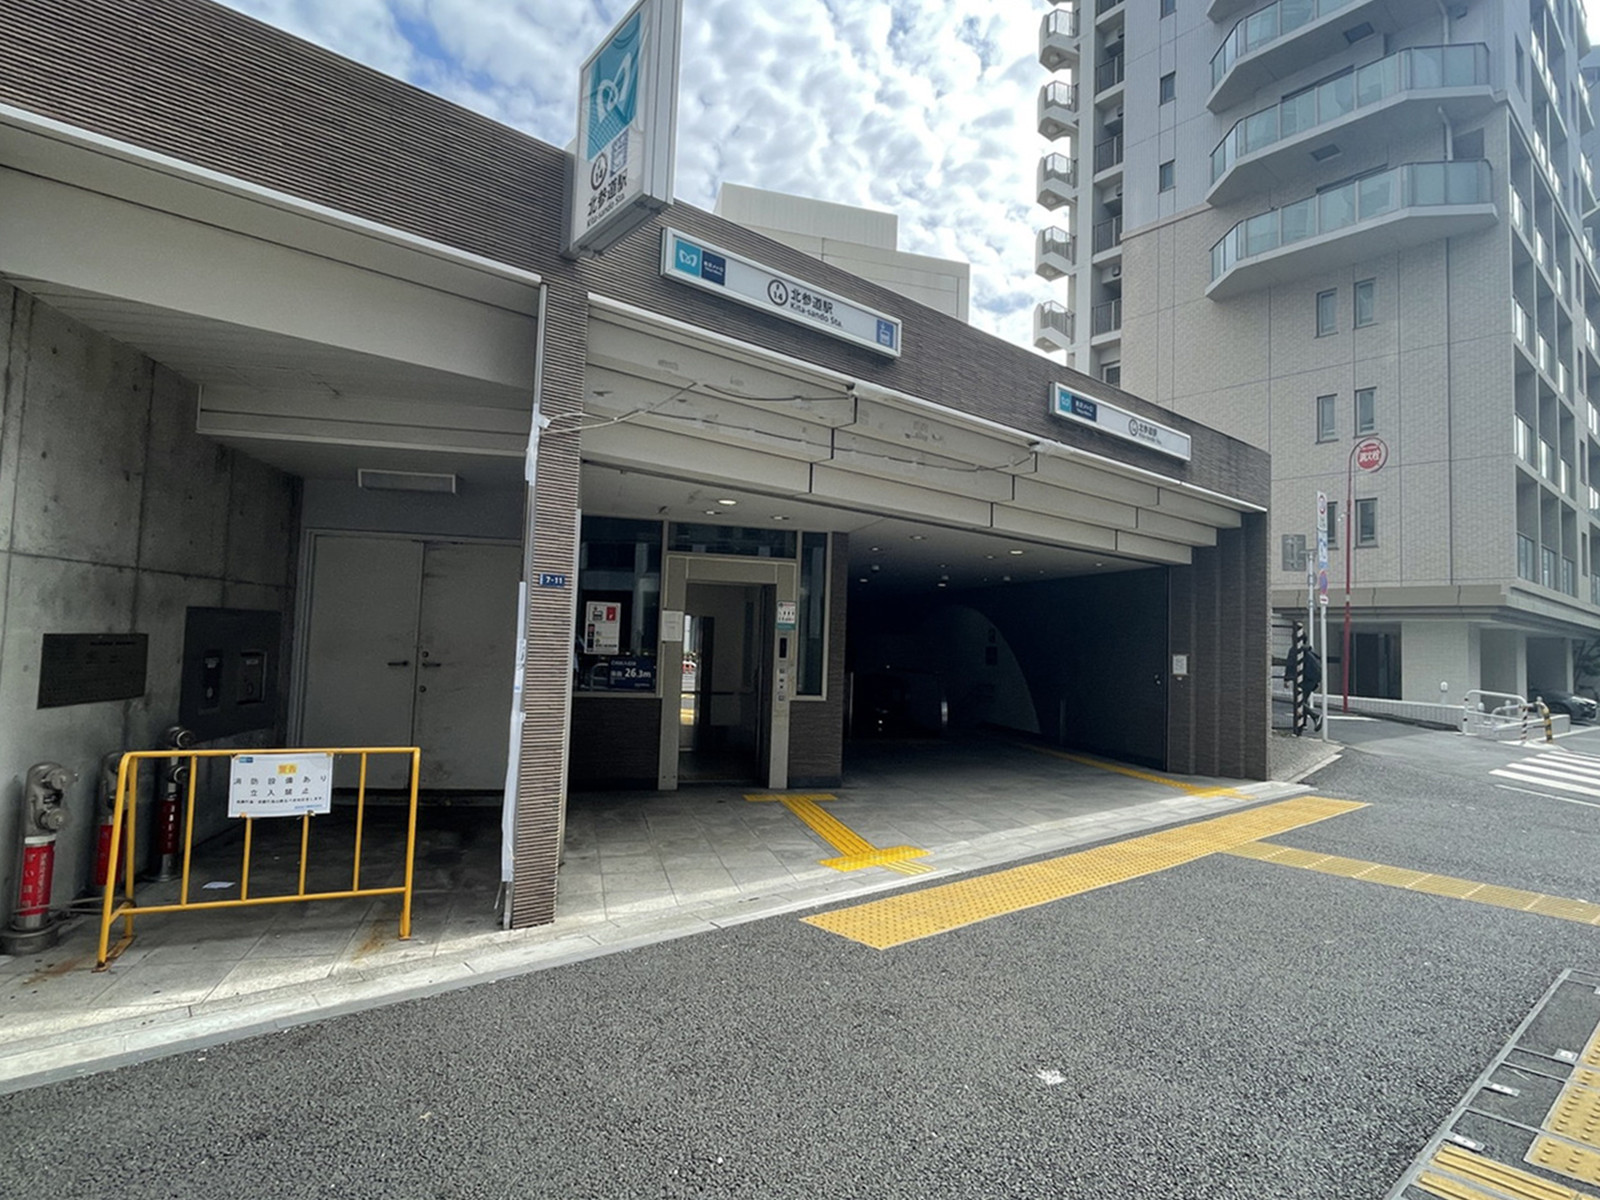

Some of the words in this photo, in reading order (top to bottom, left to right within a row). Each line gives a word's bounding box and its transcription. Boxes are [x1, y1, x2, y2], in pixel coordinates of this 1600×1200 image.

[587, 167, 628, 217] 北参道駅
[773, 291, 783, 301] 14
[790, 288, 834, 315] 北参道駅
[790, 302, 829, 323] Kita-sando
